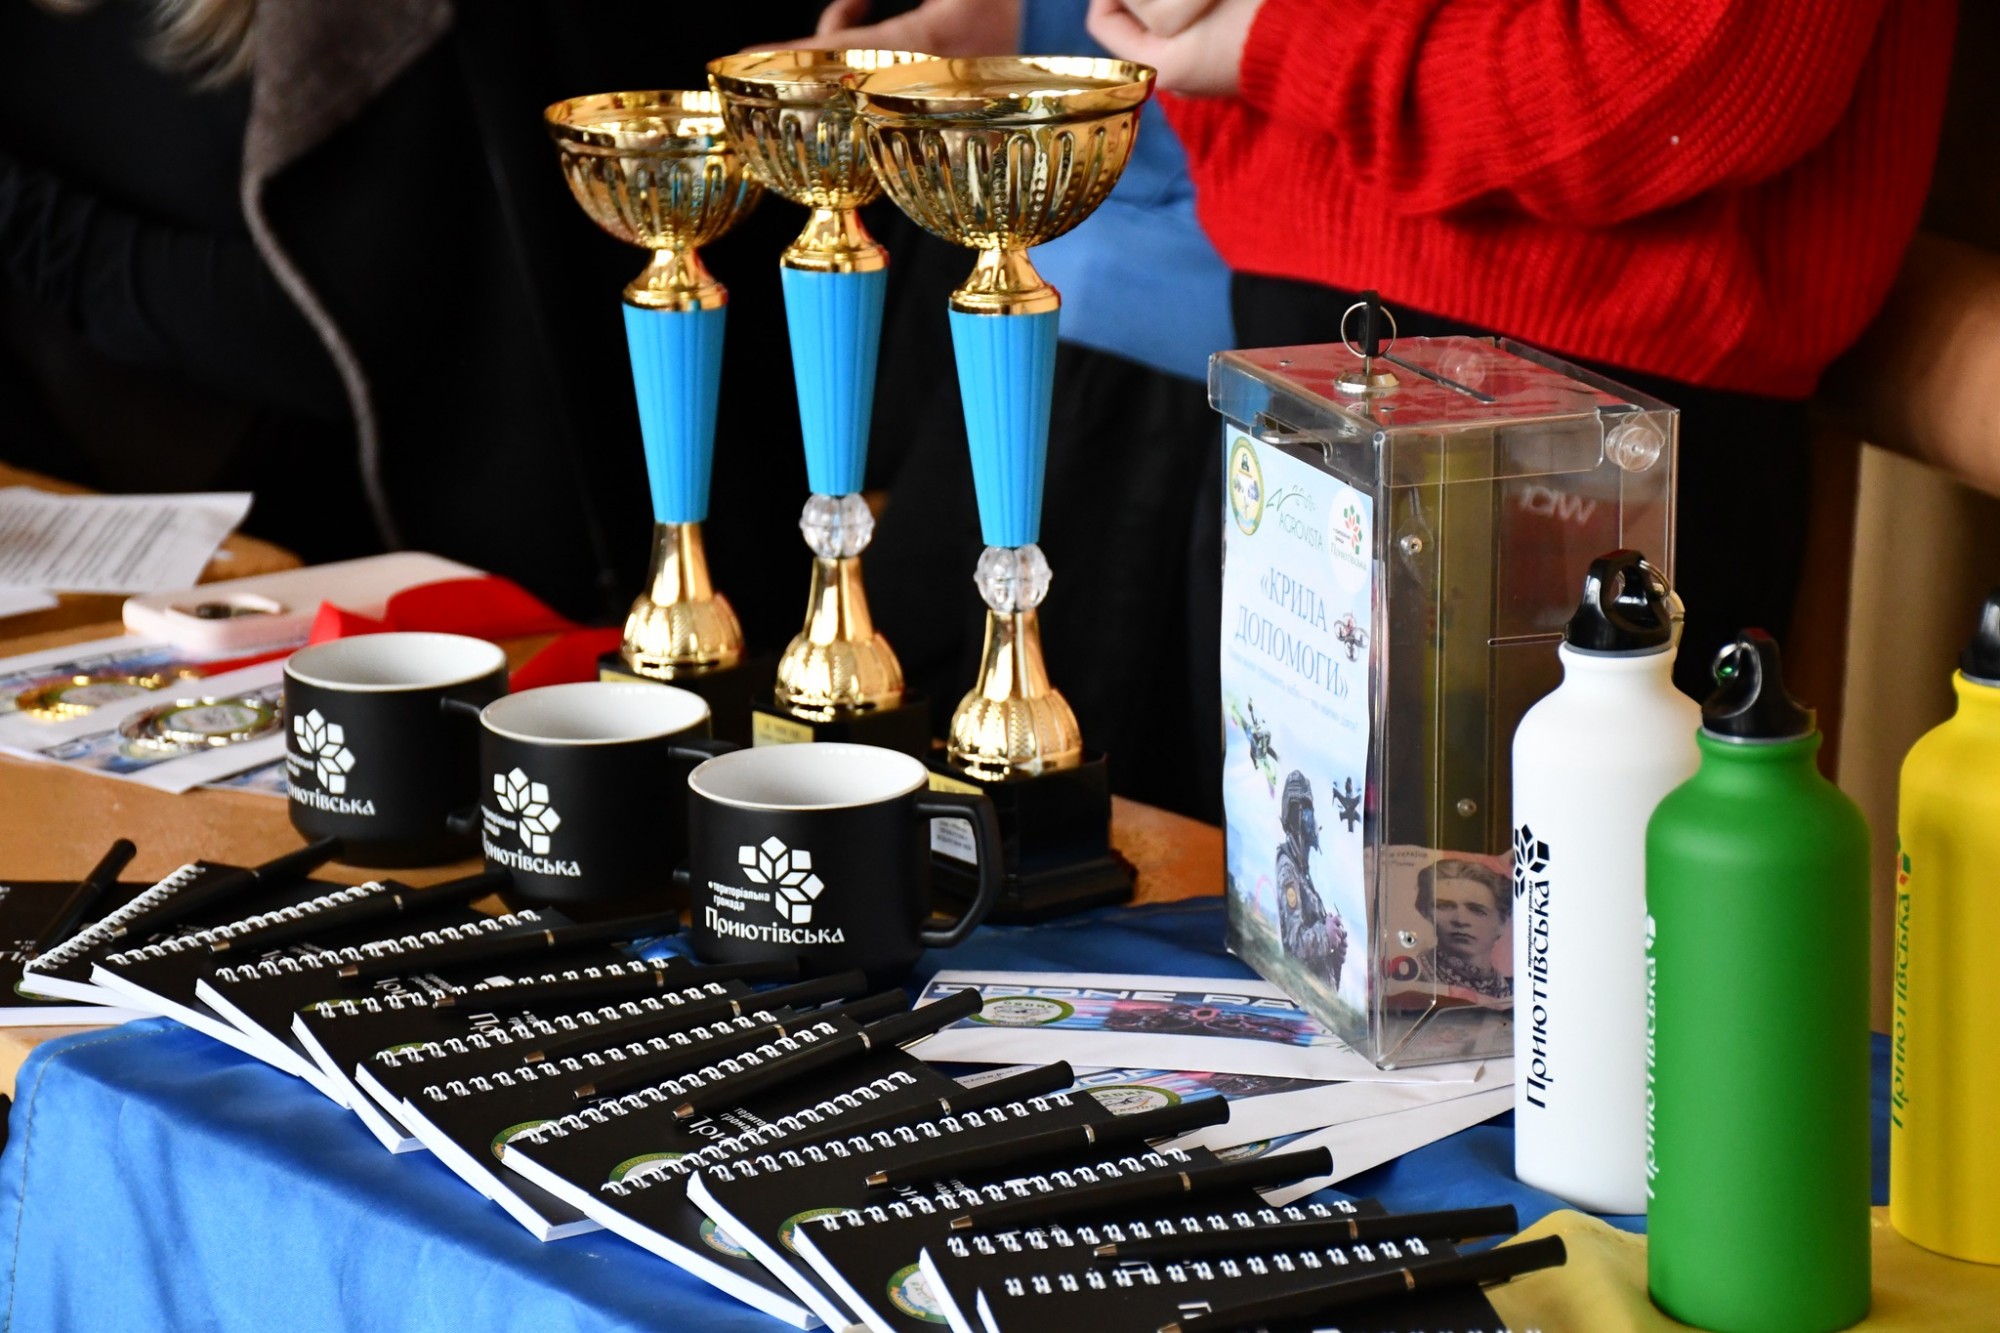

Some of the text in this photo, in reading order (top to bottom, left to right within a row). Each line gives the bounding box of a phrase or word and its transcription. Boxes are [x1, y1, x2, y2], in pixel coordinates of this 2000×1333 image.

[1279, 512, 1323, 552] AGROVISTA
[1260, 567, 1327, 633] «КРИЛА
[1235, 604, 1348, 700] ДОПОМОГИ»
[705, 905, 845, 945] Приютівська
[1527, 880, 1554, 1110] Приютівська
